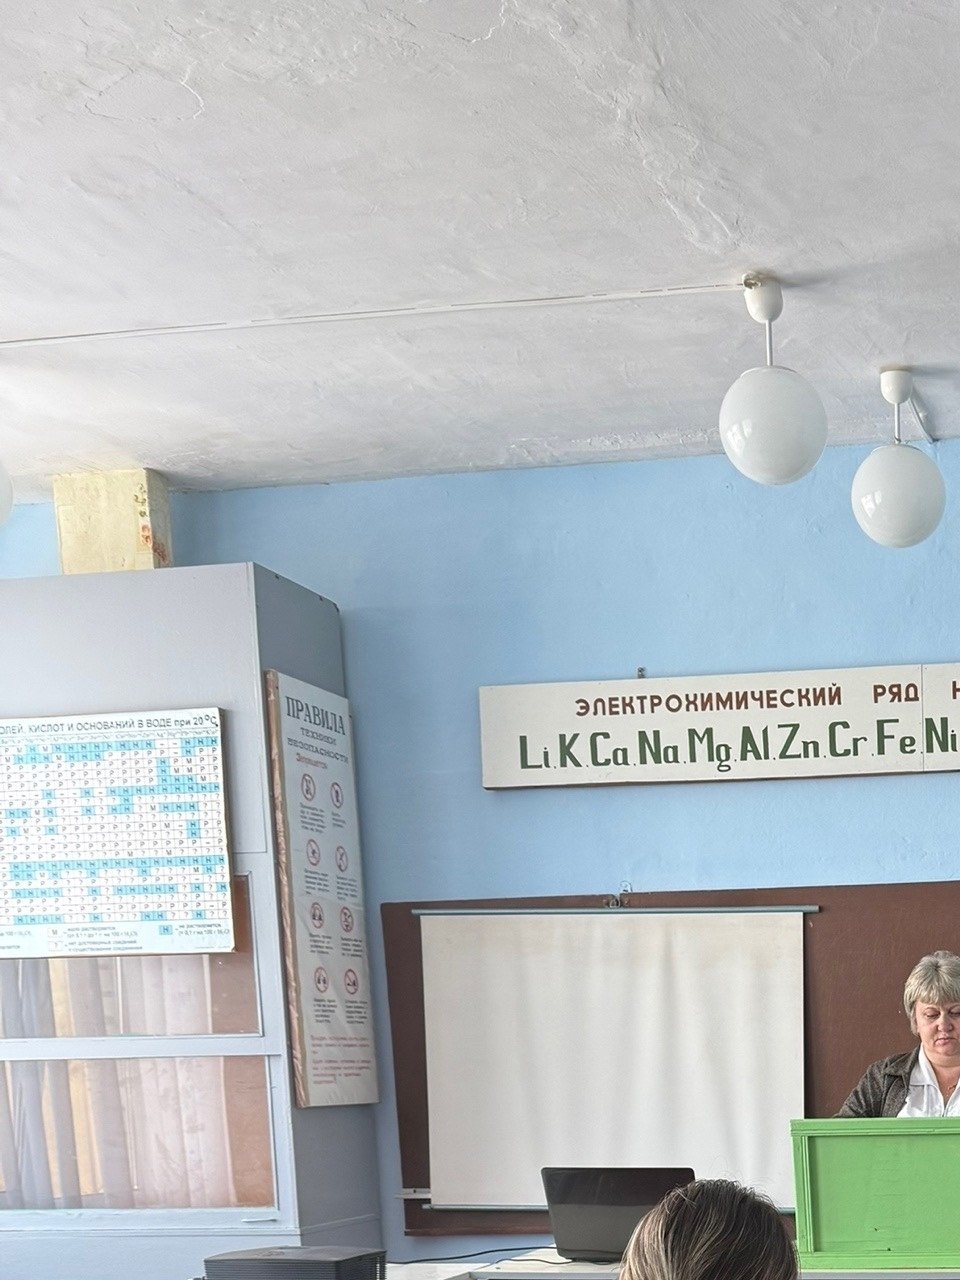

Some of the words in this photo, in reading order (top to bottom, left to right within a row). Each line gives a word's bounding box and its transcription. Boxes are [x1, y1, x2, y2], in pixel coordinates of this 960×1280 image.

[286, 697, 345, 735] ПРАВИЛА
[576, 682, 842, 717] ЭЛЕКТРОХИМИЧЕСКИЙ
[874, 683, 920, 704] РЯД
[29, 723, 64, 733] КИСЛОТ
[76, 718, 134, 731] ОСНОВАНИЙ
[146, 718, 171, 728] ВОДЕ
